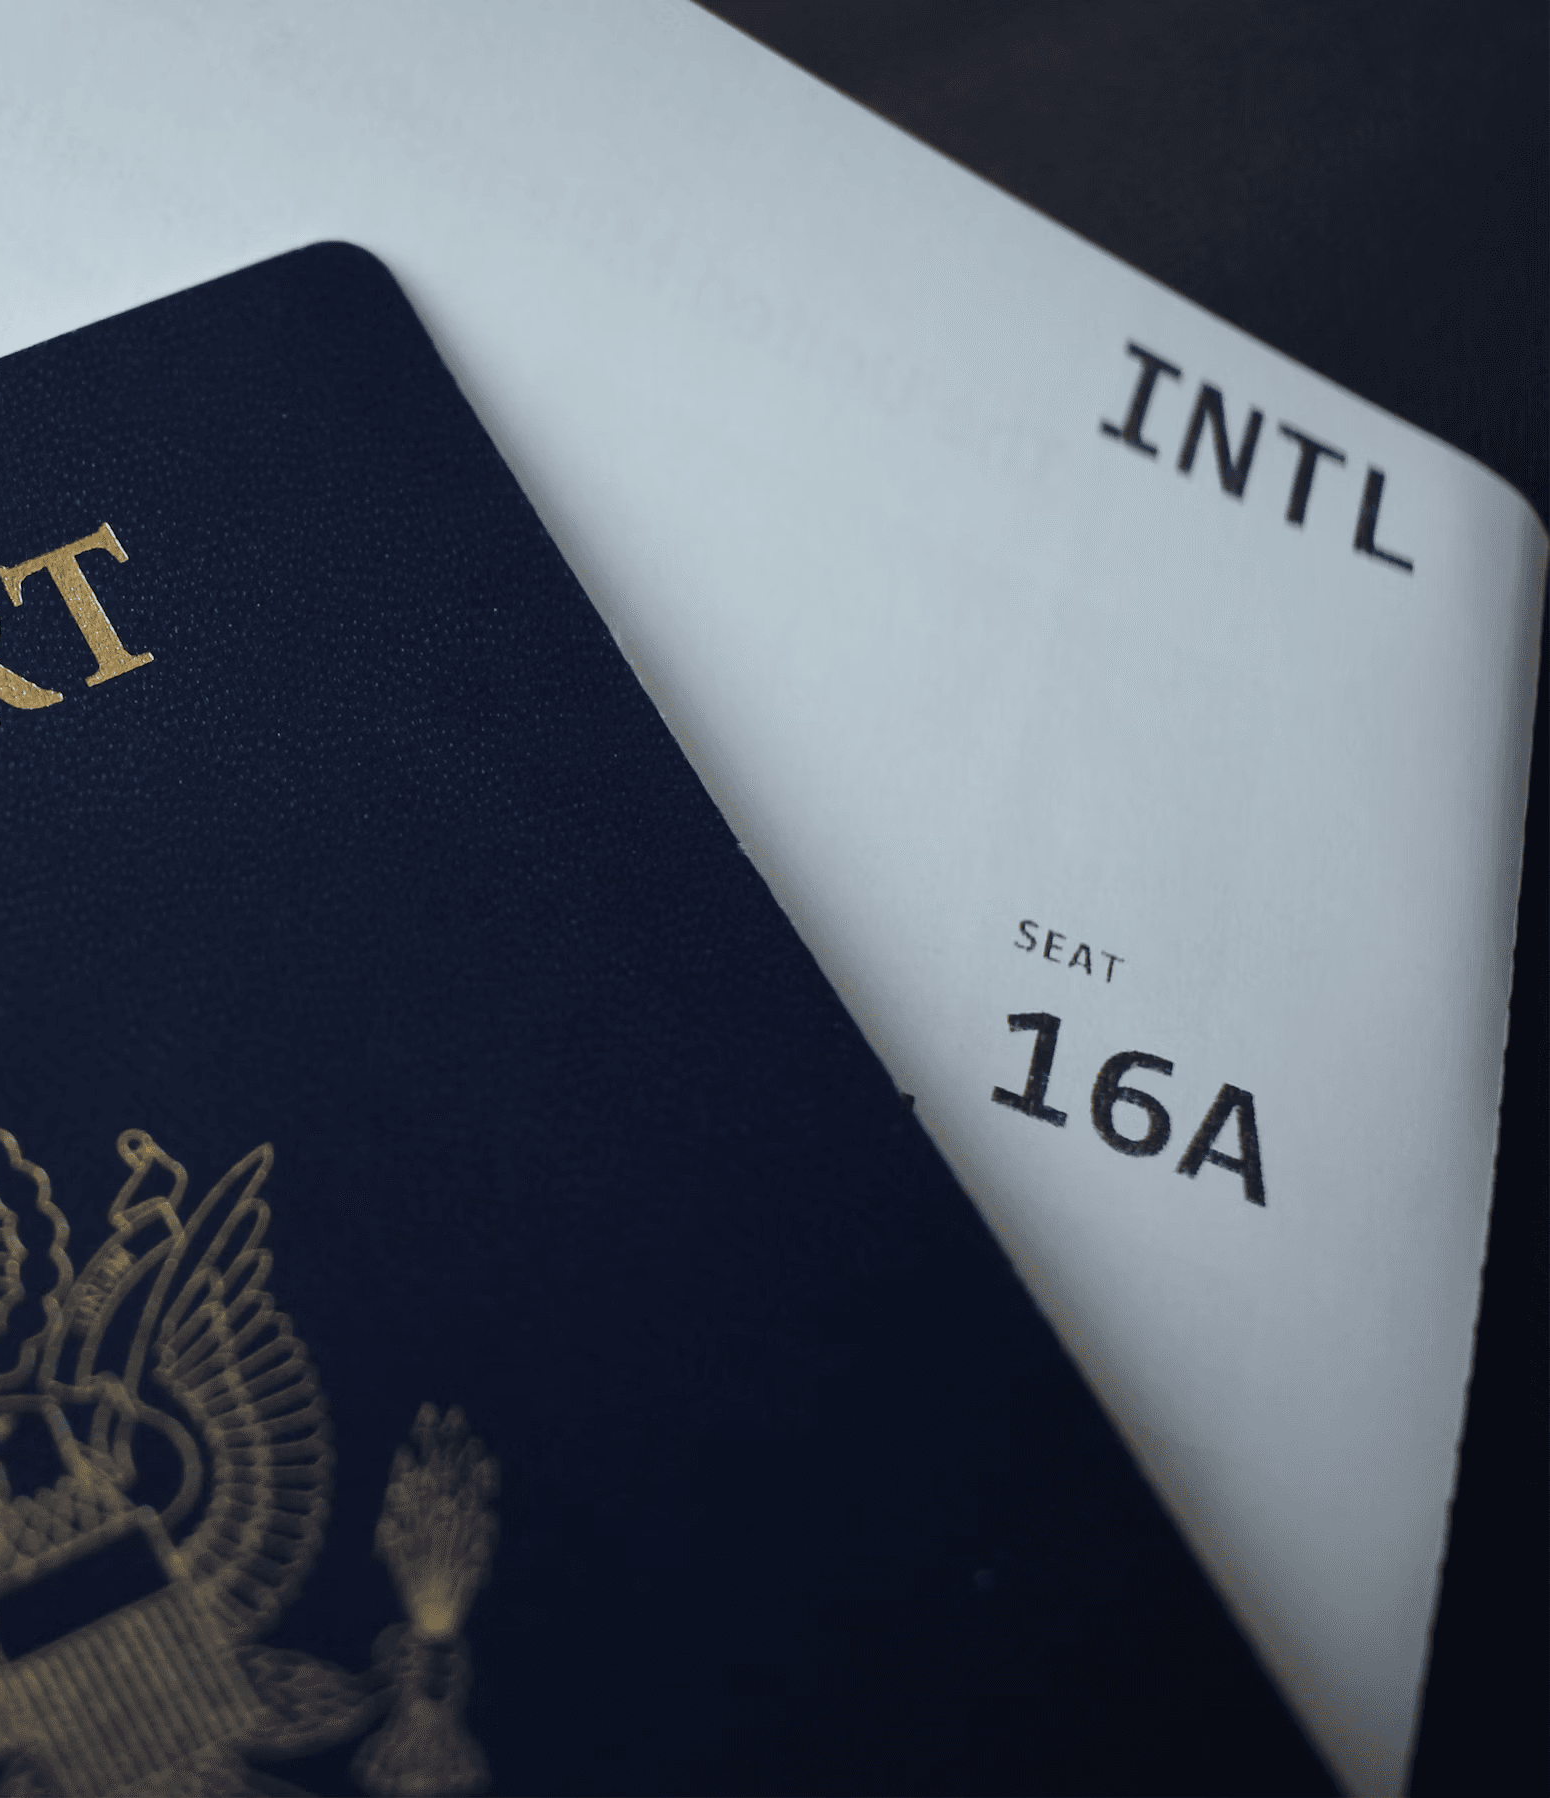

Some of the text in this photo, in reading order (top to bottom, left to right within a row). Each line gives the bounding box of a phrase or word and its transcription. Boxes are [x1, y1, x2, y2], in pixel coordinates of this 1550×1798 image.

[1098, 339, 1416, 577] INTL
[1012, 918, 1126, 985] SEAT
[990, 1011, 1267, 1208] 16A
